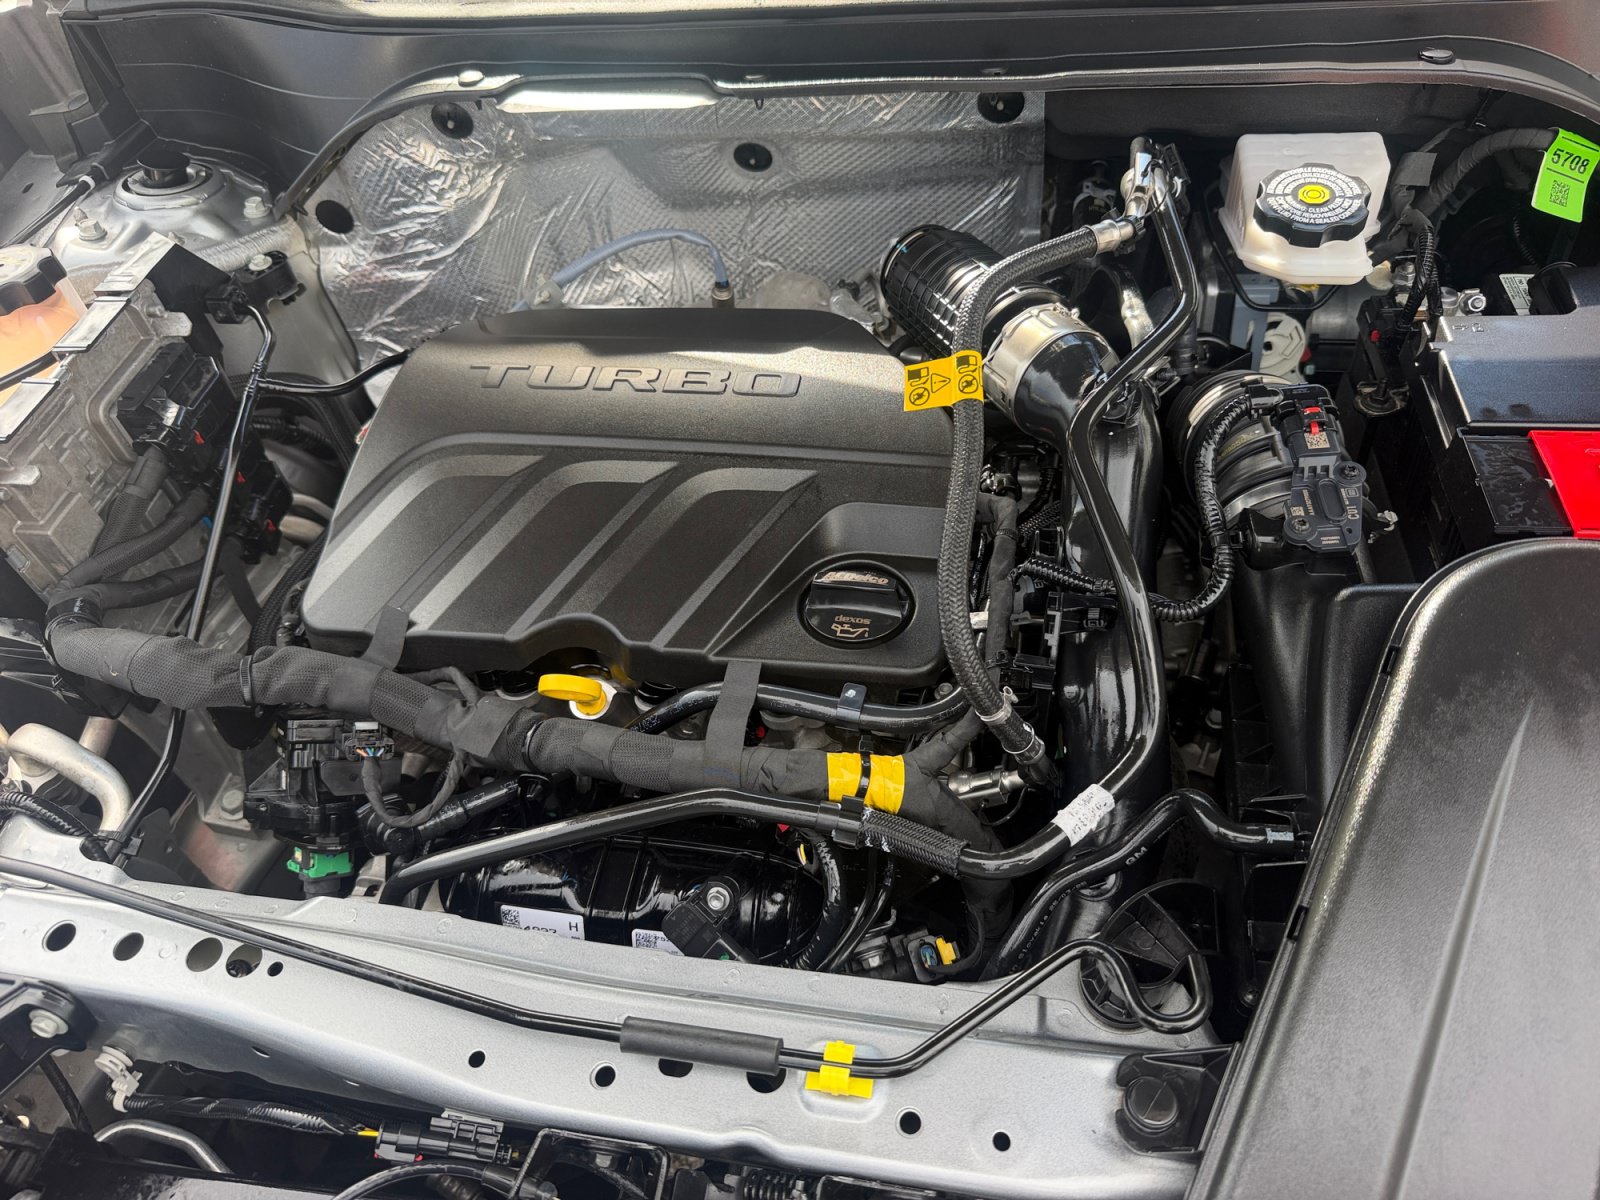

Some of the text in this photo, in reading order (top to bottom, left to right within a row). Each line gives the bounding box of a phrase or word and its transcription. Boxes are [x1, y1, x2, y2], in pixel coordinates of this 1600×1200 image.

[1551, 147, 1590, 175] 5708
[1290, 215, 1309, 223] FROM
[470, 364, 802, 397] TURBO
[834, 614, 872, 625] dexos
[1125, 846, 1148, 866] GM
[568, 921, 579, 932] H
